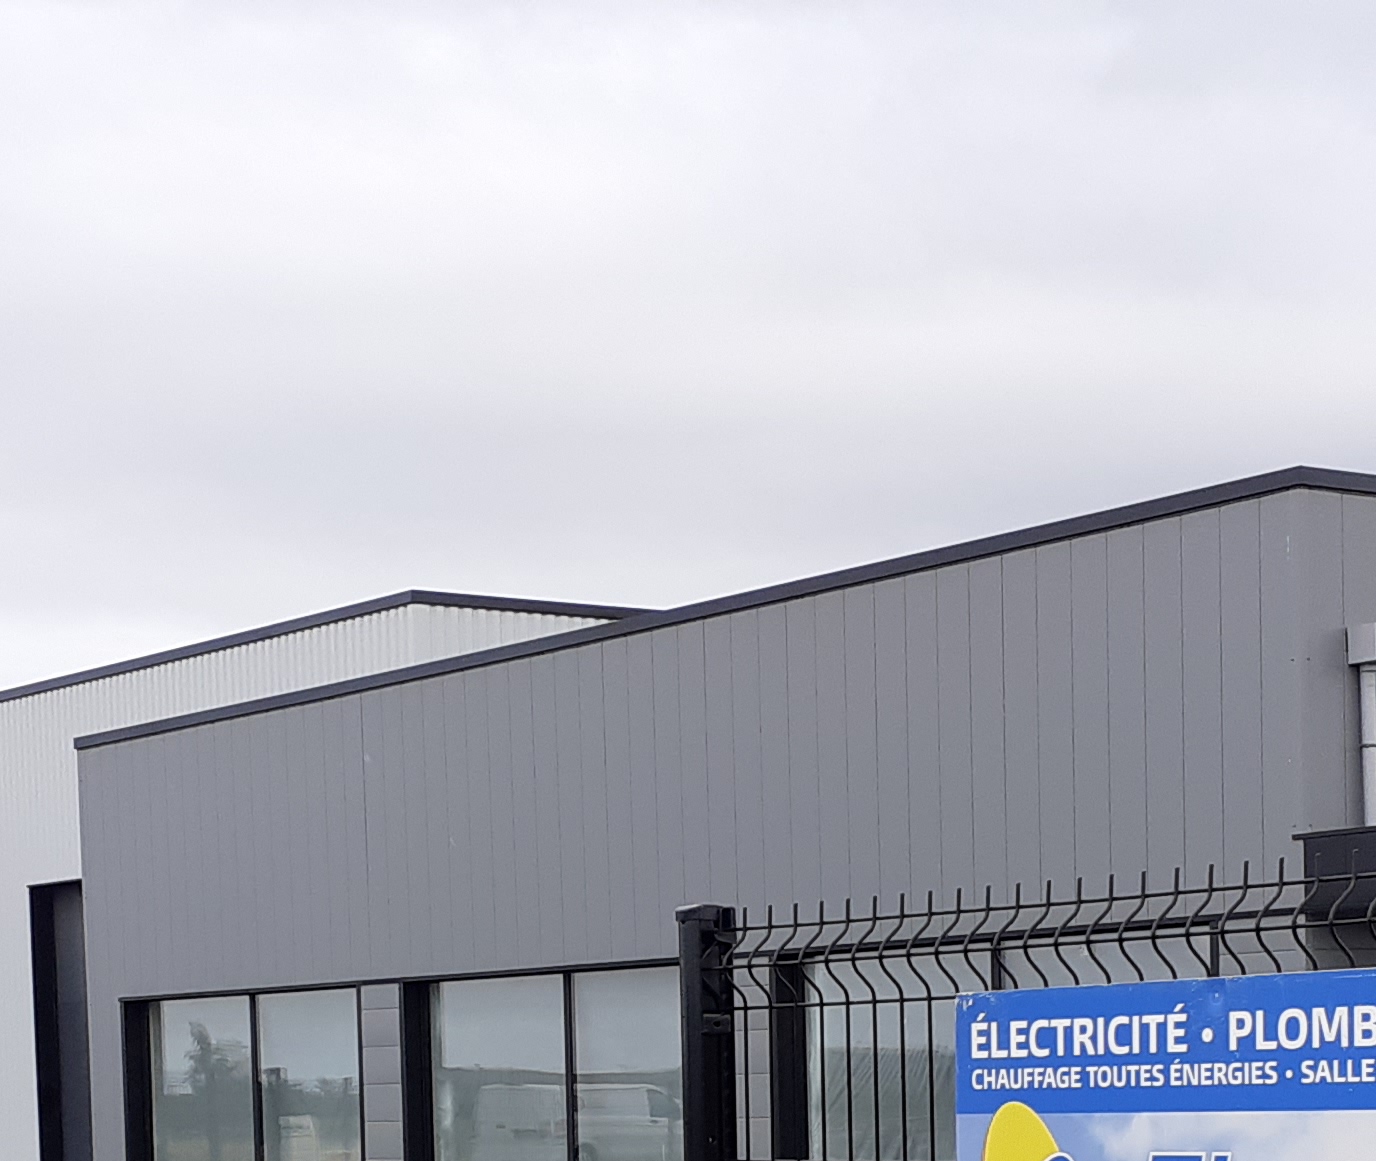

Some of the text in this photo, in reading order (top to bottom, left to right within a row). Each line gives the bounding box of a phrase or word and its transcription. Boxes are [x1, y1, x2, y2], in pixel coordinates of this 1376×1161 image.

[971, 1003, 1188, 1059] ÉLECTRICITÉ
[971, 1067, 1082, 1090] CHAUFFAGE
[1086, 1064, 1164, 1088] TOUTES
[1169, 1059, 1278, 1086] ÉNERGIES
[1300, 1059, 1376, 1084] SALLE
